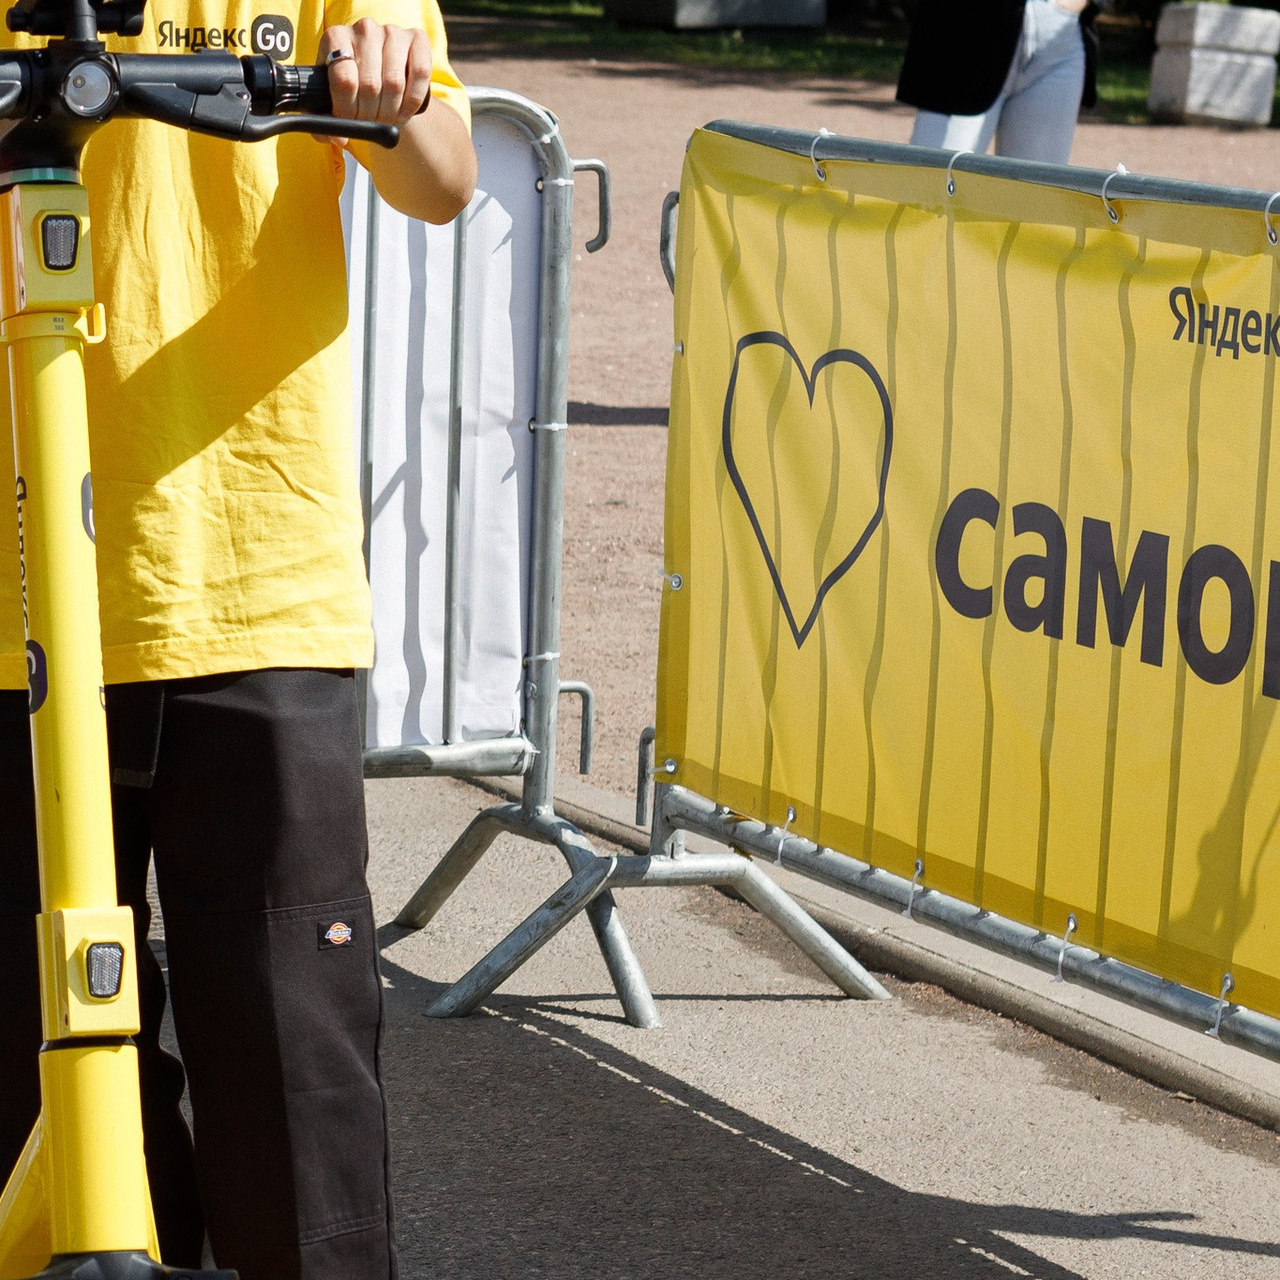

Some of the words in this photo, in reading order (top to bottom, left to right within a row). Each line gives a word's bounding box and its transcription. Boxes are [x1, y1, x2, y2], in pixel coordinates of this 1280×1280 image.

[158, 20, 247, 53] Яндекс
[256, 22, 291, 52] Go
[935, 487, 1280, 701] само
